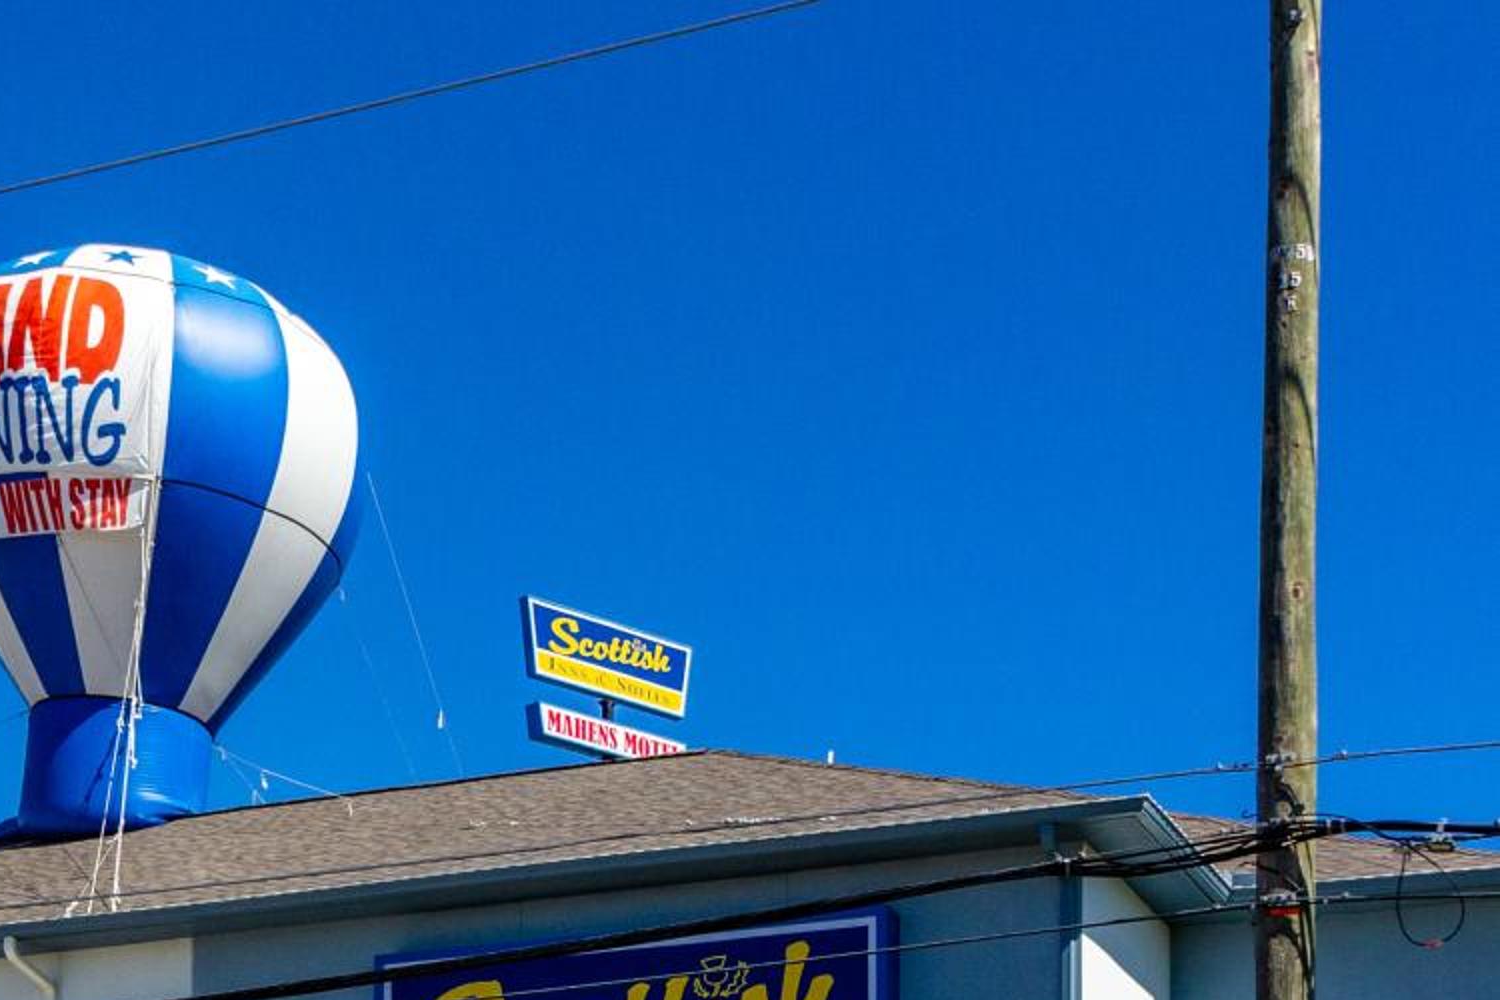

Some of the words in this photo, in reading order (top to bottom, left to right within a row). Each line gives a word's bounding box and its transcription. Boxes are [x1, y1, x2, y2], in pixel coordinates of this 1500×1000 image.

[0, 478, 65, 534] WITH
[69, 477, 133, 531] STAY
[548, 617, 671, 673] Scottish
[624, 730, 678, 758] MOTE
